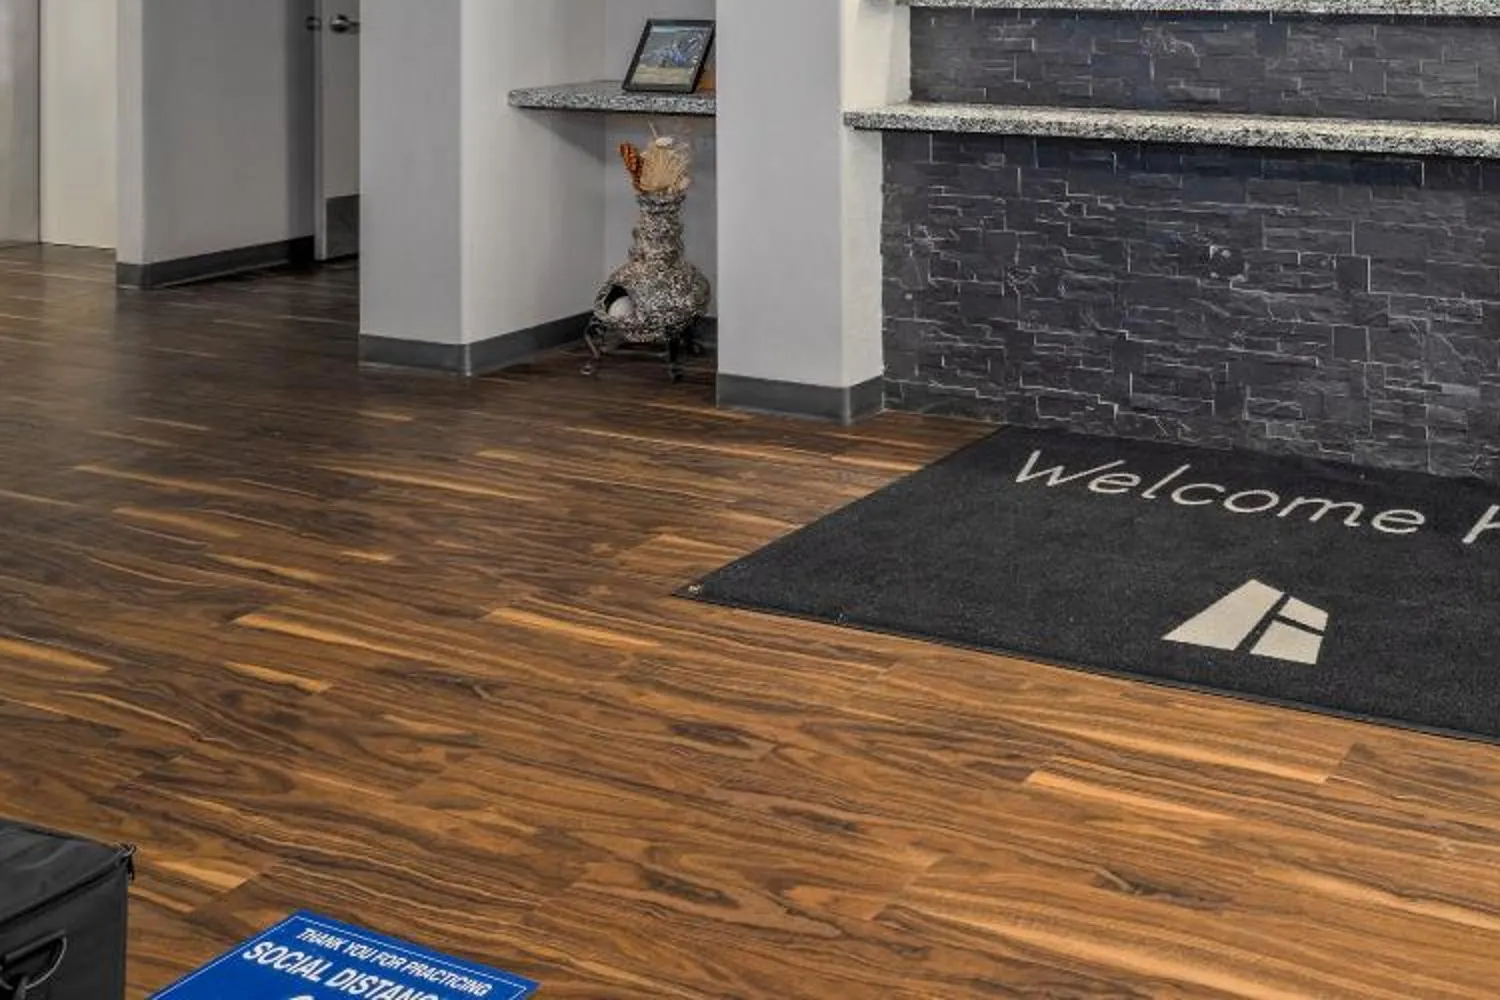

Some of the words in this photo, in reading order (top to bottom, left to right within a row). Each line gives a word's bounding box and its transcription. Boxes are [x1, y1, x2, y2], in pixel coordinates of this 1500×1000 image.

[1015, 449, 1426, 534] Welcome
[242, 941, 333, 982] SOCIAL
[296, 927, 347, 951] THANK
[342, 939, 378, 960] YOU
[370, 949, 407, 971] FOR
[399, 960, 493, 998] PRACTICING
